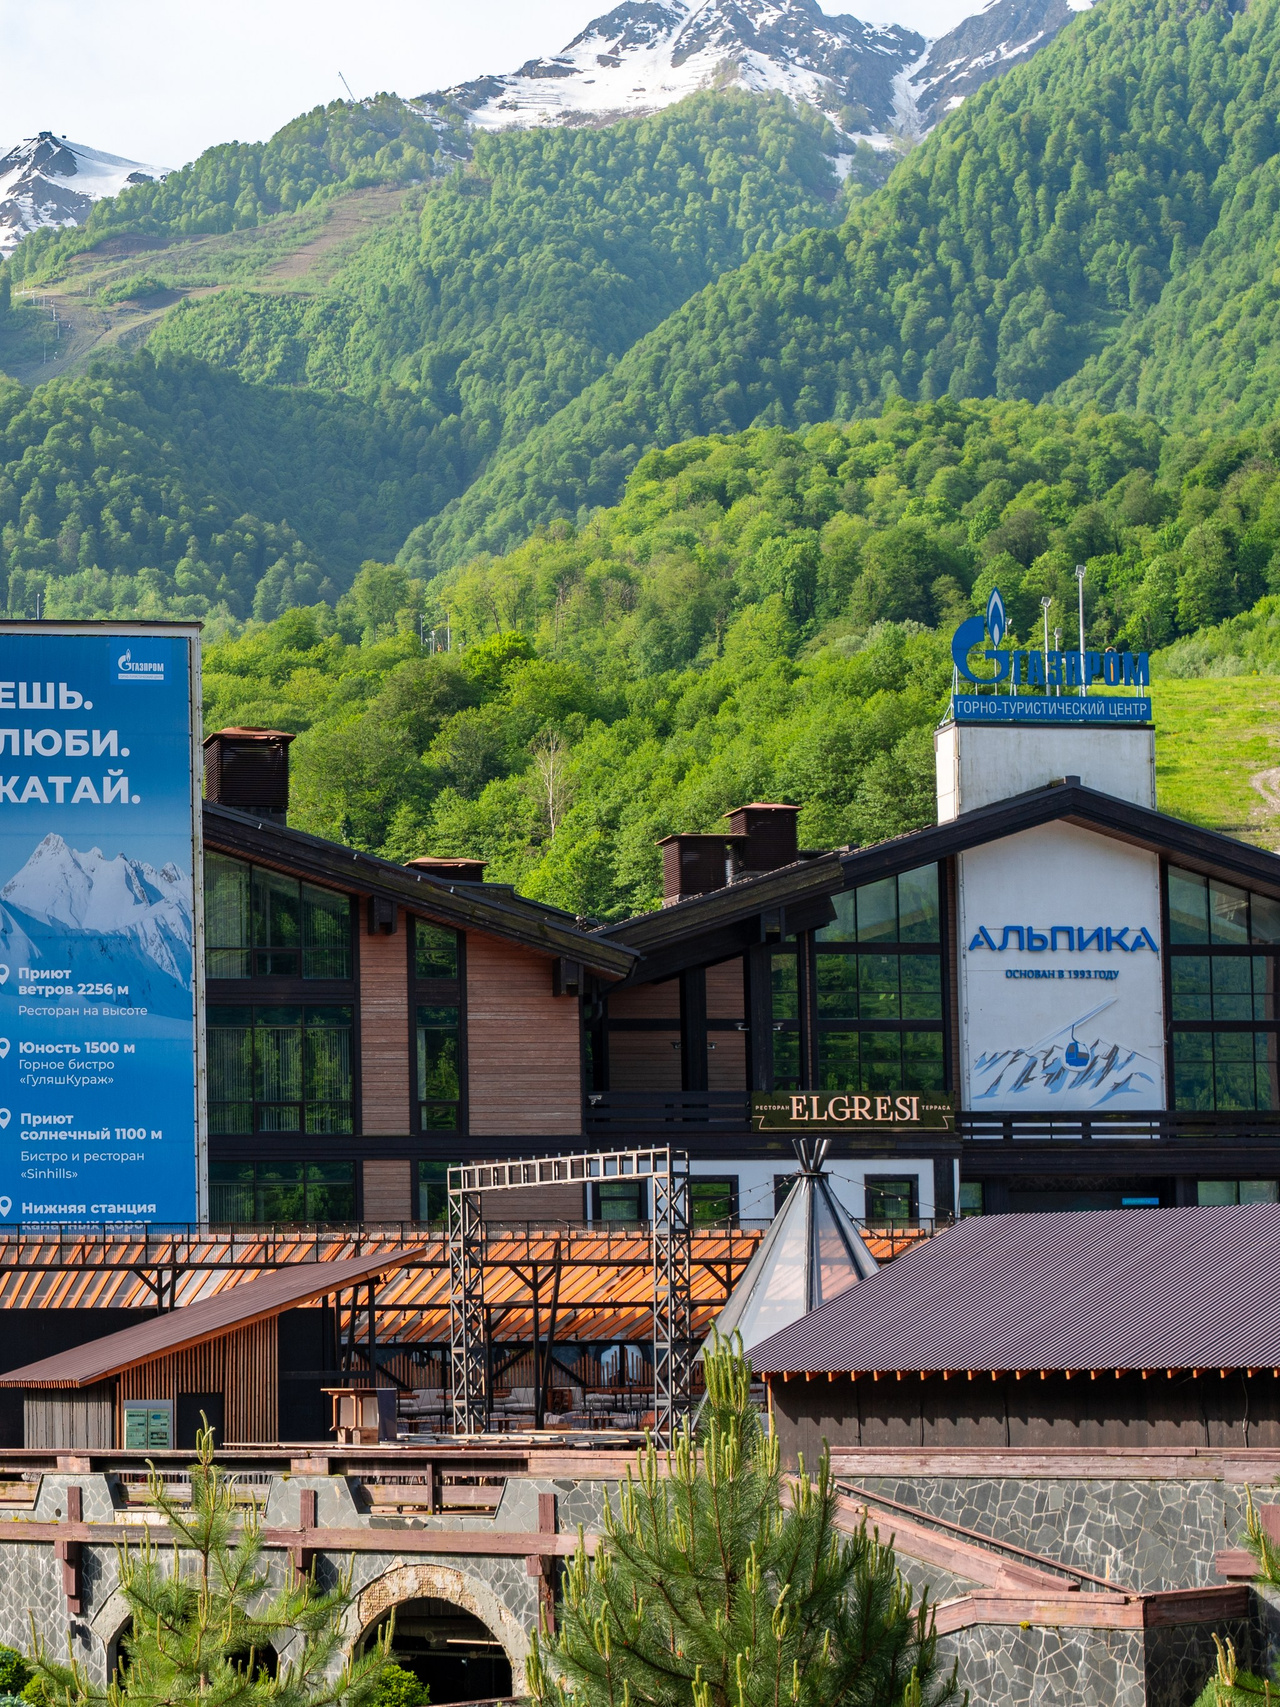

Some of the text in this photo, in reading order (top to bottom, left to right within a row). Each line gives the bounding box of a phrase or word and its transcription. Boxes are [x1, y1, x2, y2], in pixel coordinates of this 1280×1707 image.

[131, 662, 164, 672] ГАЗПРОМ
[1013, 650, 1150, 687] ГАЗПРОМ
[957, 700, 1148, 717] ГОРНО-ТУРИСТИЧЕСКИЙ ЦЕНТР
[969, 925, 1159, 952] АЛЬПИКА
[18, 967, 72, 981] Приют
[1005, 969, 1119, 980] ОСНОВАН В 1993 ГОДУ
[18, 983, 129, 998] ветров 2256 м
[18, 1005, 148, 1018] Ресторан на высоте
[19, 1042, 135, 1054] Юность 1500 м
[19, 1059, 115, 1072] Горное бистро
[20, 1075, 114, 1087] «ГуляшКураж»
[789, 1095, 920, 1121] ELGRESI
[20, 1112, 74, 1127] Приют
[20, 1127, 163, 1140] солнечный 1100 м
[21, 1151, 145, 1164] Бистро и ресторан
[21, 1168, 78, 1179] «Sinhills»
[21, 1202, 157, 1215] Нижняя станция
[21, 1220, 100, 1231] канатных
